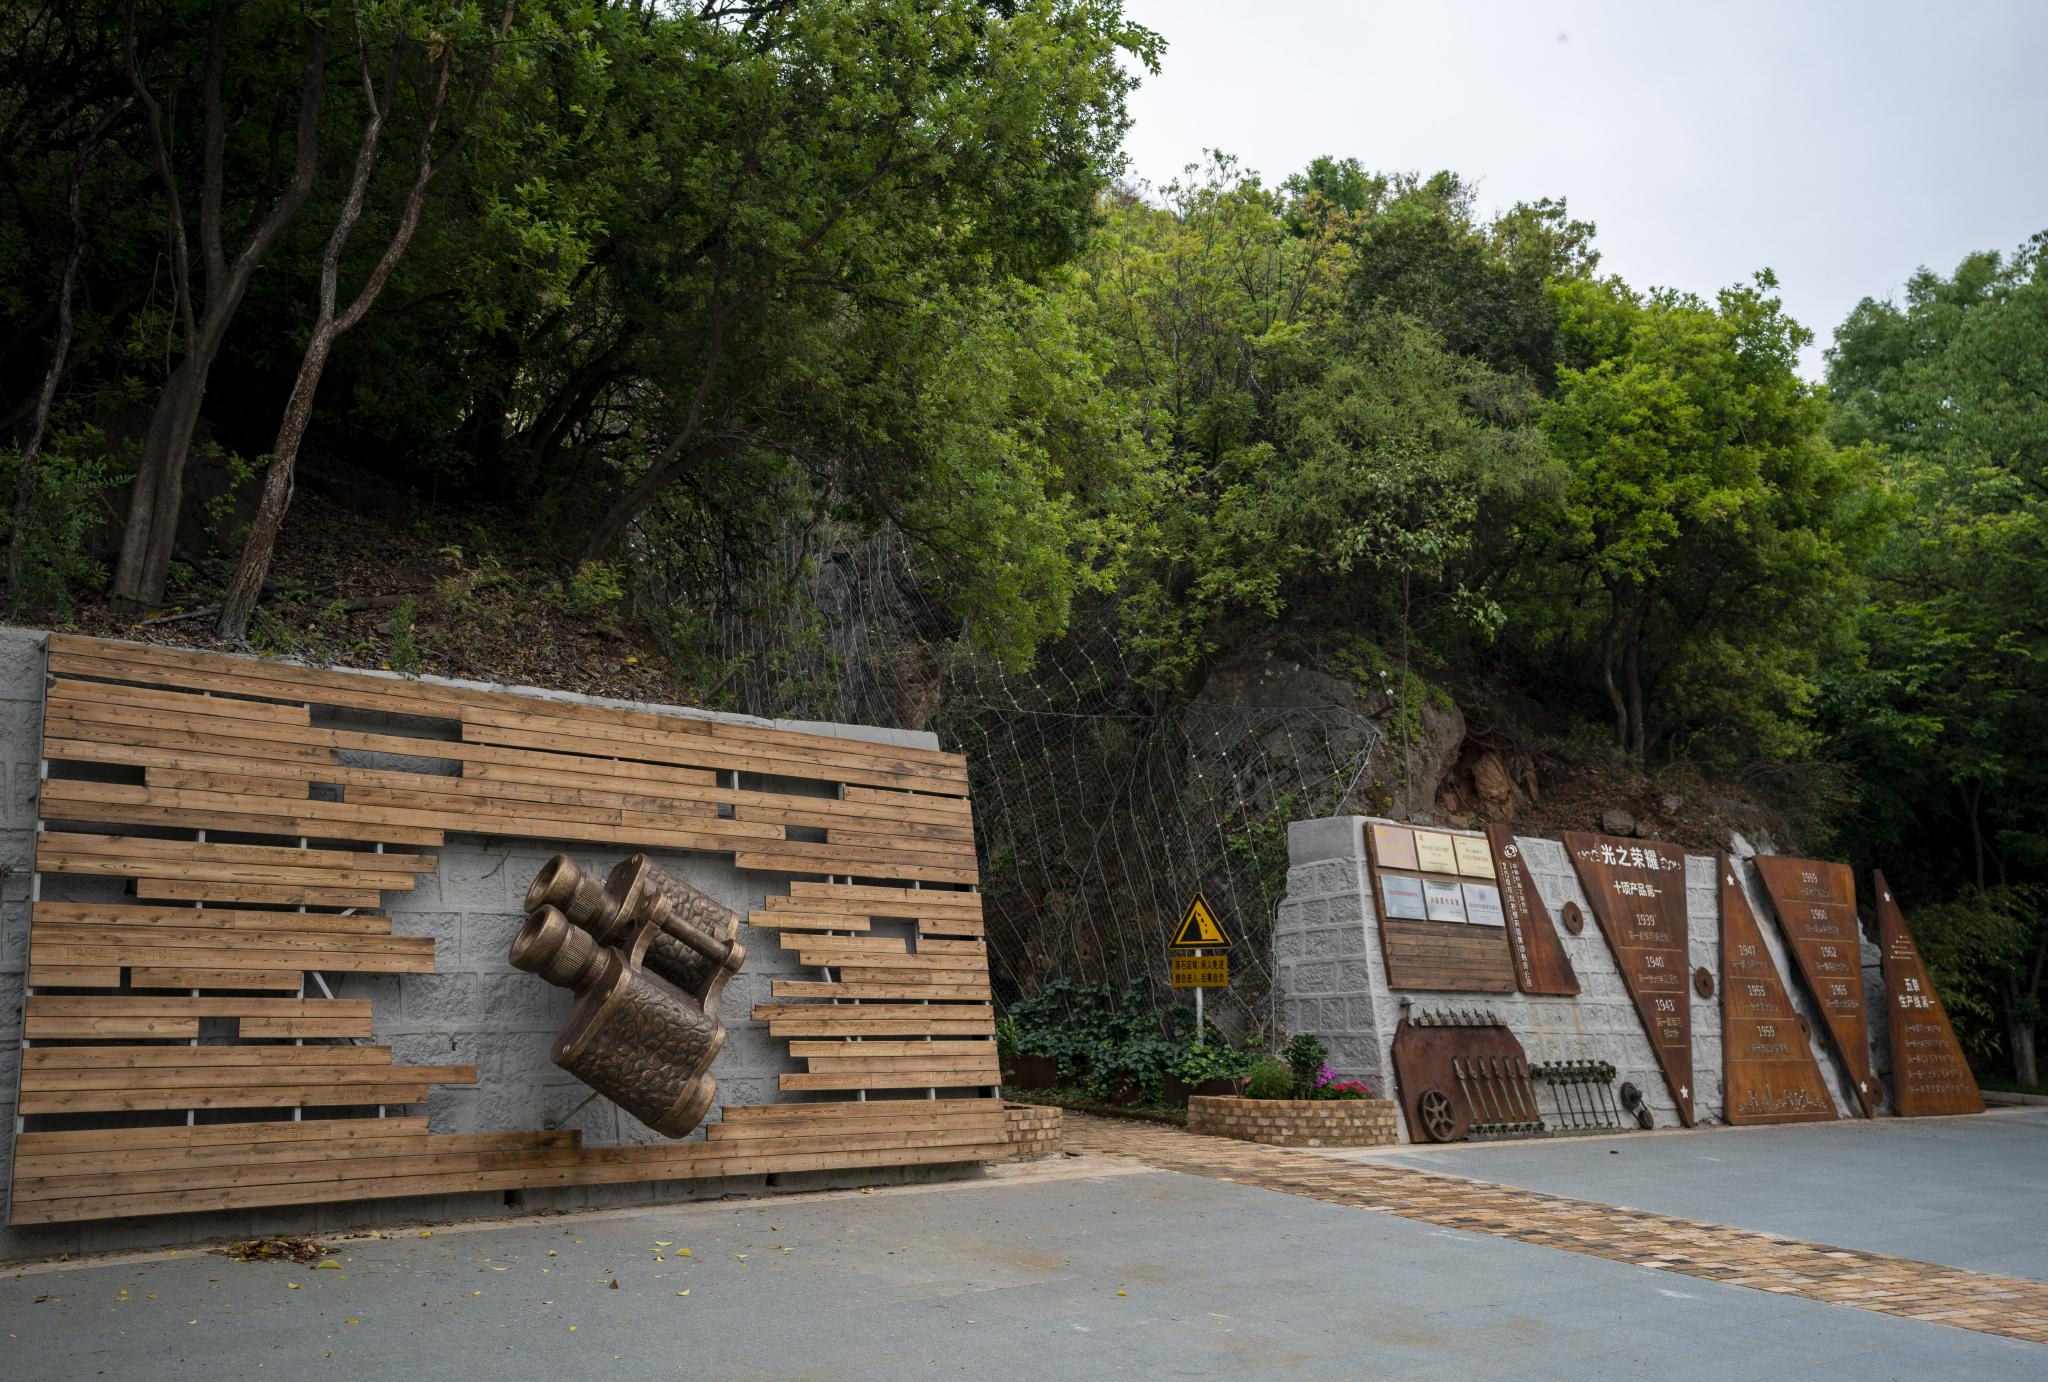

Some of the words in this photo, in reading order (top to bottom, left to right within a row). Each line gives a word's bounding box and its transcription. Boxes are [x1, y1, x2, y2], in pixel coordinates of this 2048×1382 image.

[1601, 843, 1660, 870] 光之荣耀
[1613, 880, 1662, 898] 十项产品第一
[1636, 913, 1656, 926] 1939
[1645, 956, 1665, 968] 1940
[1747, 984, 1766, 997] 1955
